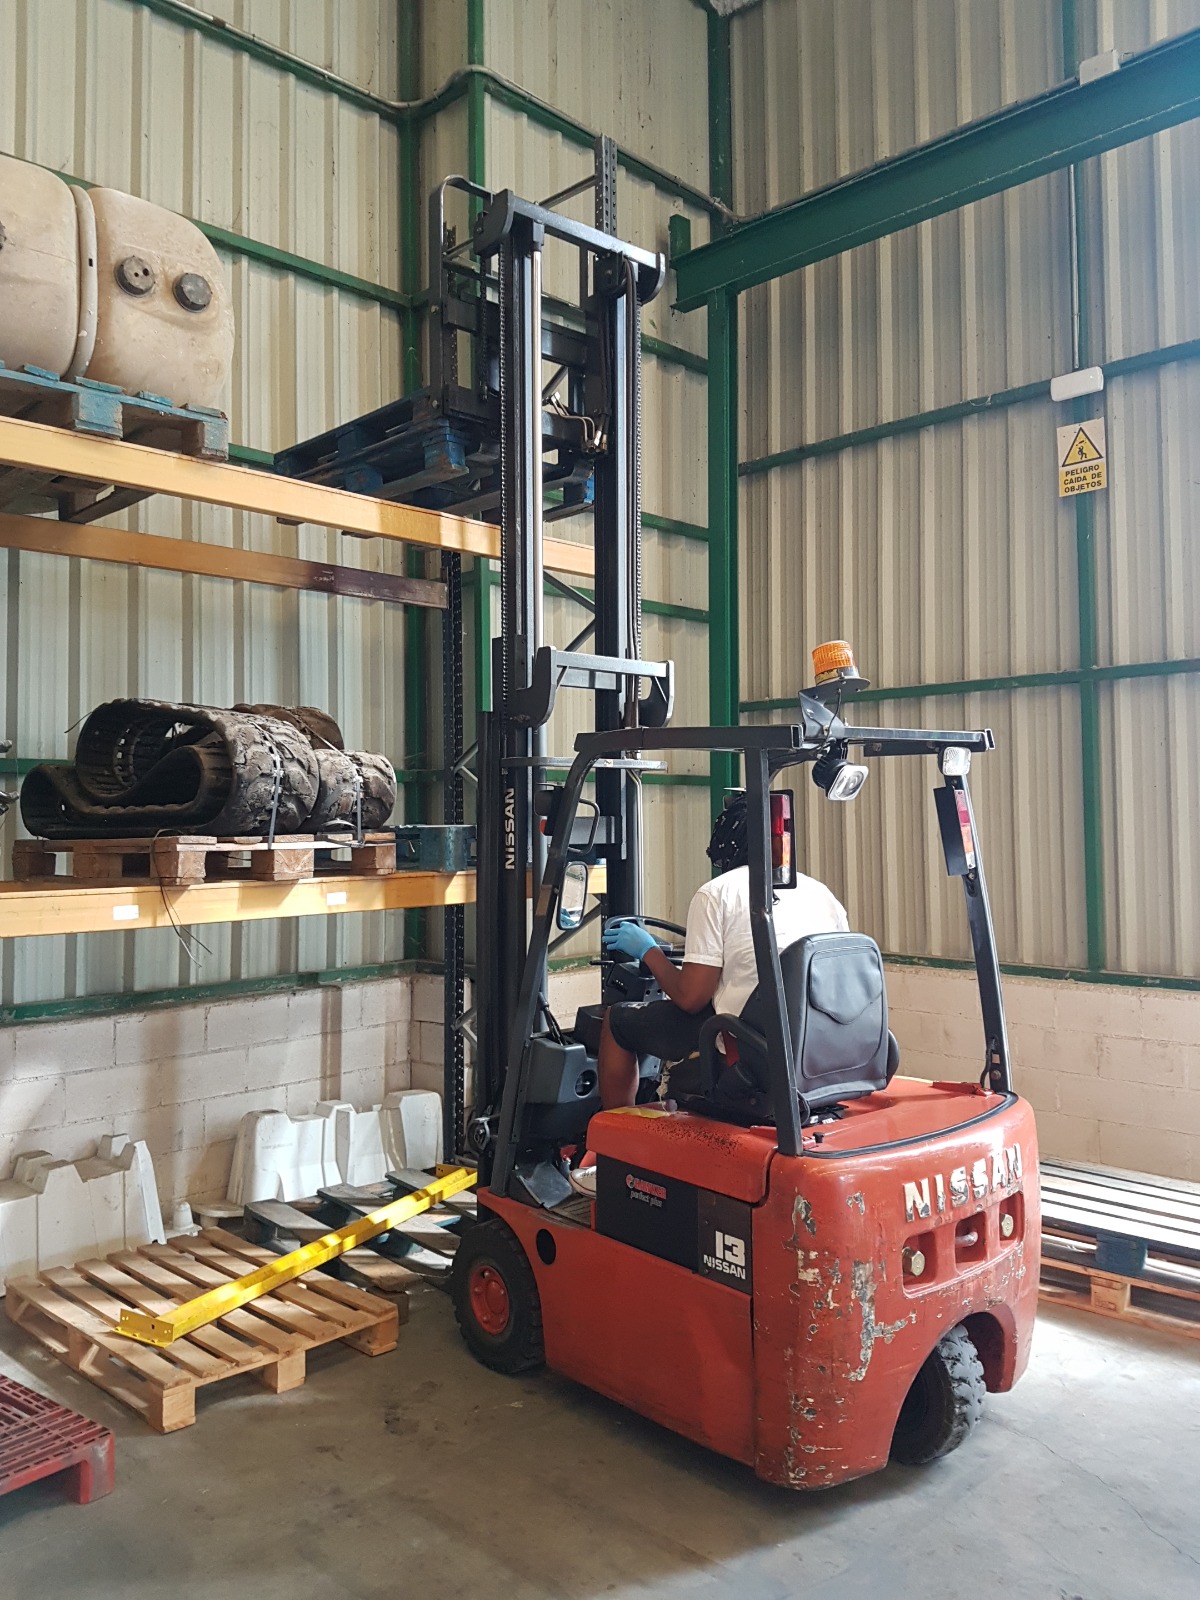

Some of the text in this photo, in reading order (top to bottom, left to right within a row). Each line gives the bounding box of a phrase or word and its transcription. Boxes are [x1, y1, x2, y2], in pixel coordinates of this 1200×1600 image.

[1063, 471, 1103, 486] CAIDA DE
[1065, 464, 1100, 477] PELIGRO
[1064, 480, 1102, 493] OBJETOS
[504, 787, 515, 870] NISSAN
[903, 1143, 1023, 1223] NISSAN
[715, 1230, 746, 1267] 13
[703, 1254, 746, 1280] NISSAN
